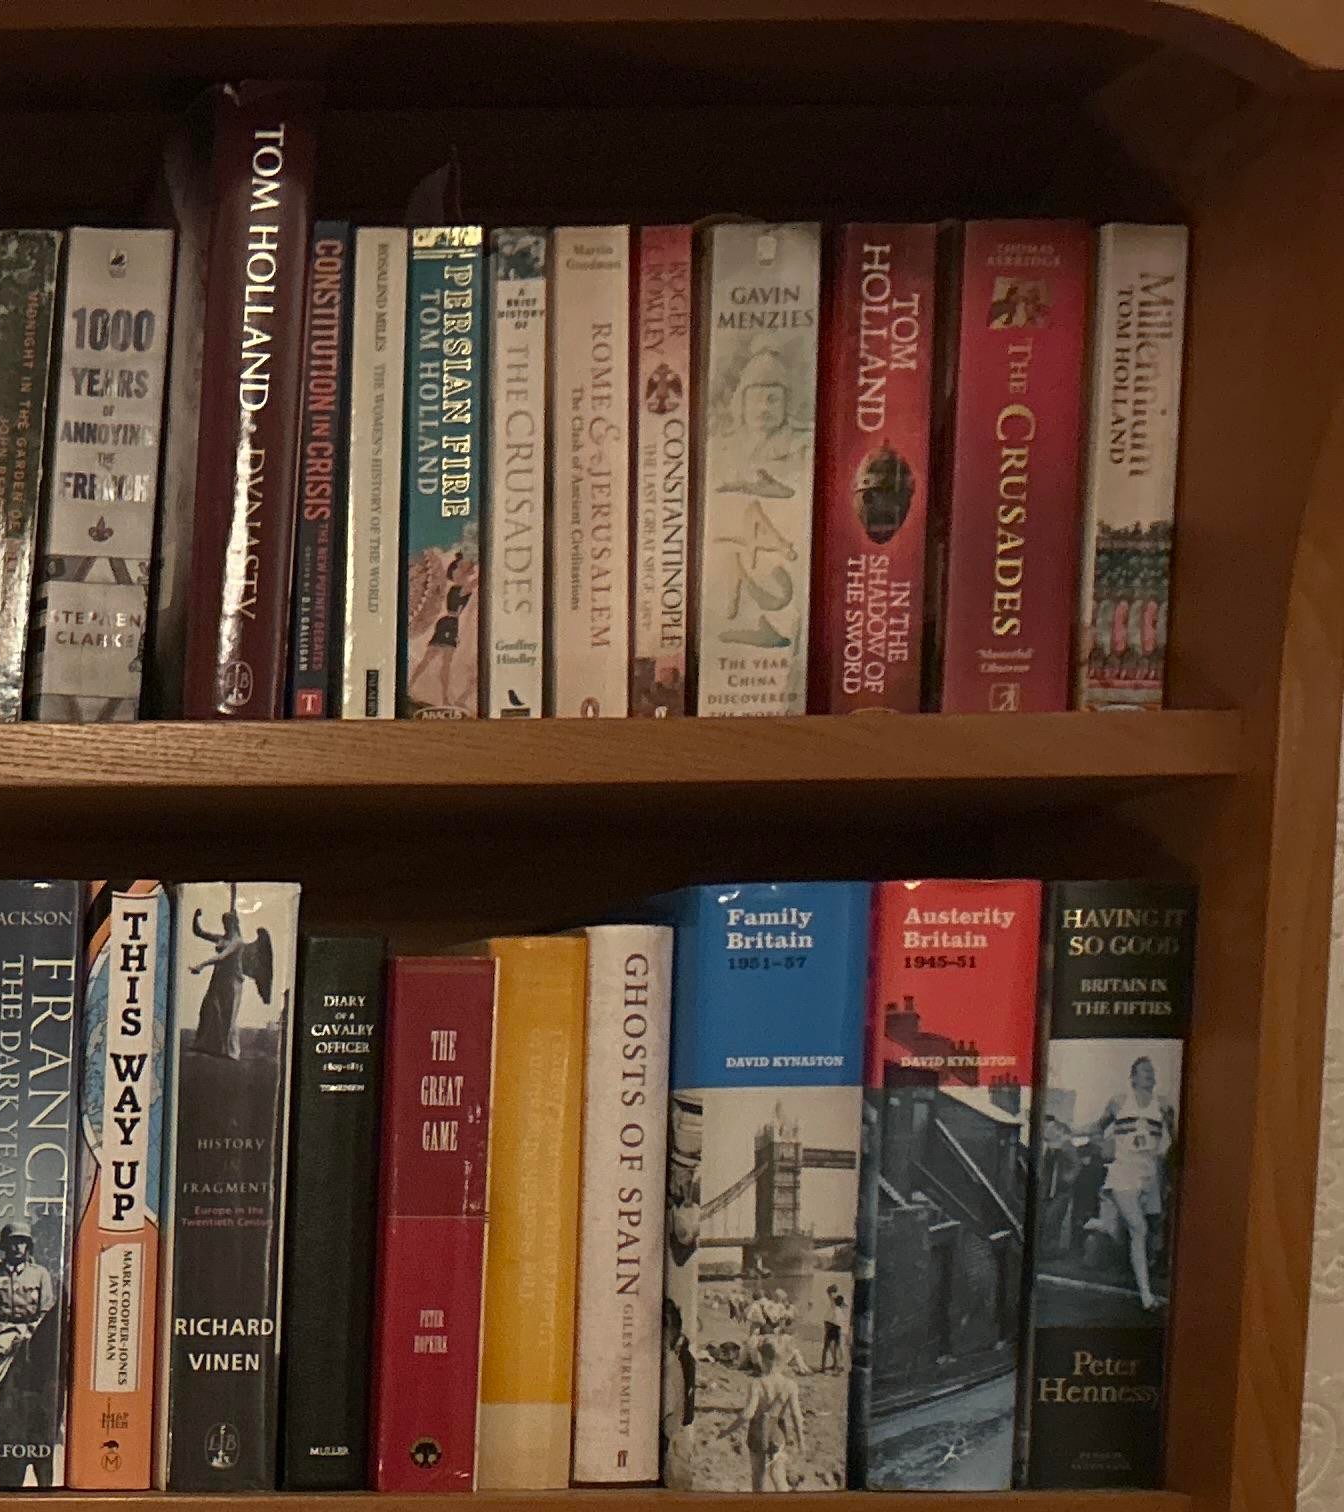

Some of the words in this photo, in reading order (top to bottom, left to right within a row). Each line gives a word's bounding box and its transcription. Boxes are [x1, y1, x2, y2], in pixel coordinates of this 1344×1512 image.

[251, 123, 285, 212] TOM
[238, 225, 280, 414] HOLLAND
[717, 311, 814, 329] MENZIES
[731, 288, 800, 305] GAVIN
[442, 264, 473, 423] PERSIAN
[1009, 340, 1033, 395] THE
[441, 434, 470, 519] FIRE
[992, 403, 1037, 638] CRUSADES
[661, 417, 684, 647] CONSTANTINOPLE
[727, 908, 812, 930] Family
[727, 932, 813, 950] Britain
[120, 912, 148, 1036] THIS
[622, 952, 648, 1114] GHOSTS
[726, 1056, 768, 1068] DAVID
[772, 1055, 844, 1068] KYNASTON
[24, 958, 74, 1216] FRANCE
[110, 1054, 146, 1146] WAY
[620, 1122, 644, 1170] OF
[111, 1161, 140, 1221] UP
[616, 1188, 643, 1296] SPAIN
